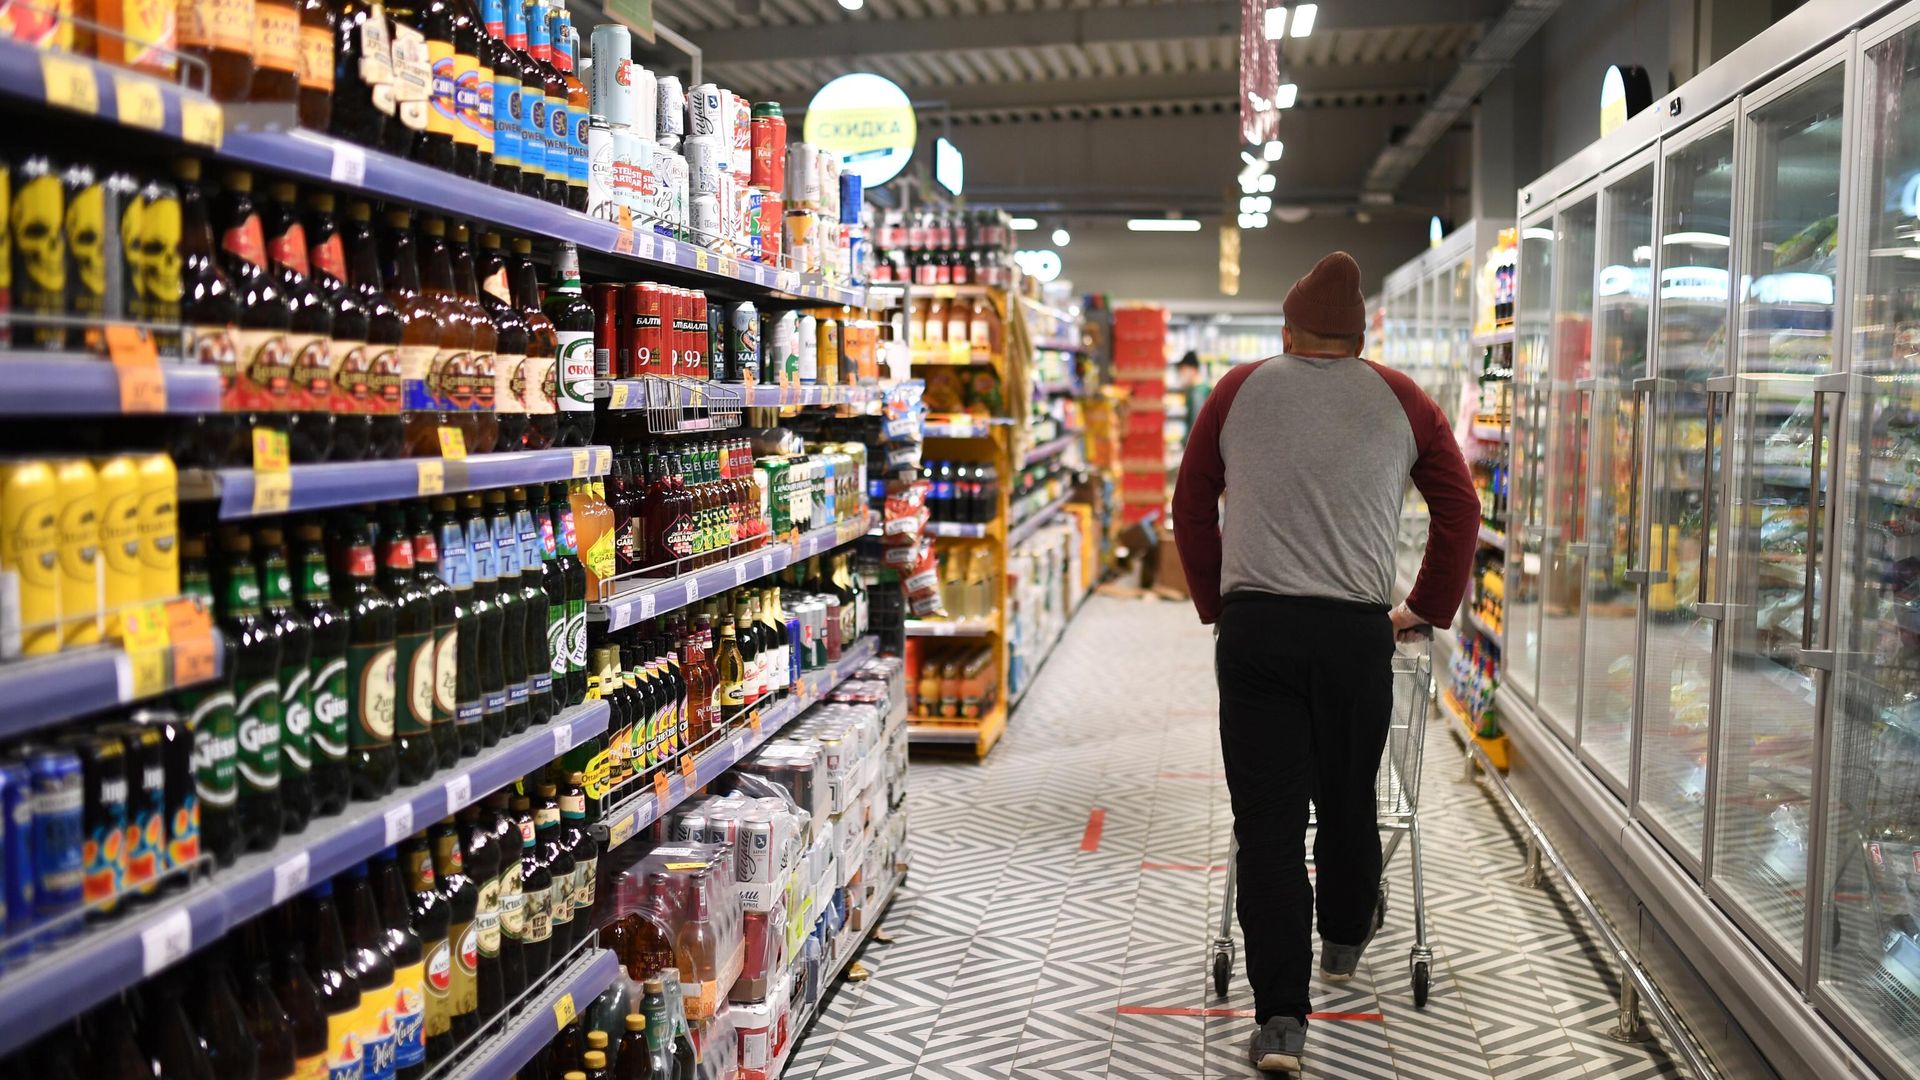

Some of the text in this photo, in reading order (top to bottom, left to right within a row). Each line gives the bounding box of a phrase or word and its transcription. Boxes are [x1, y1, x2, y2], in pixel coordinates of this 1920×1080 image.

[818, 120, 902, 139] СКИДКА
[638, 346, 650, 366] 9
[502, 555, 511, 572] 7
[524, 548, 533, 565] 7
[478, 559, 487, 577] 7
